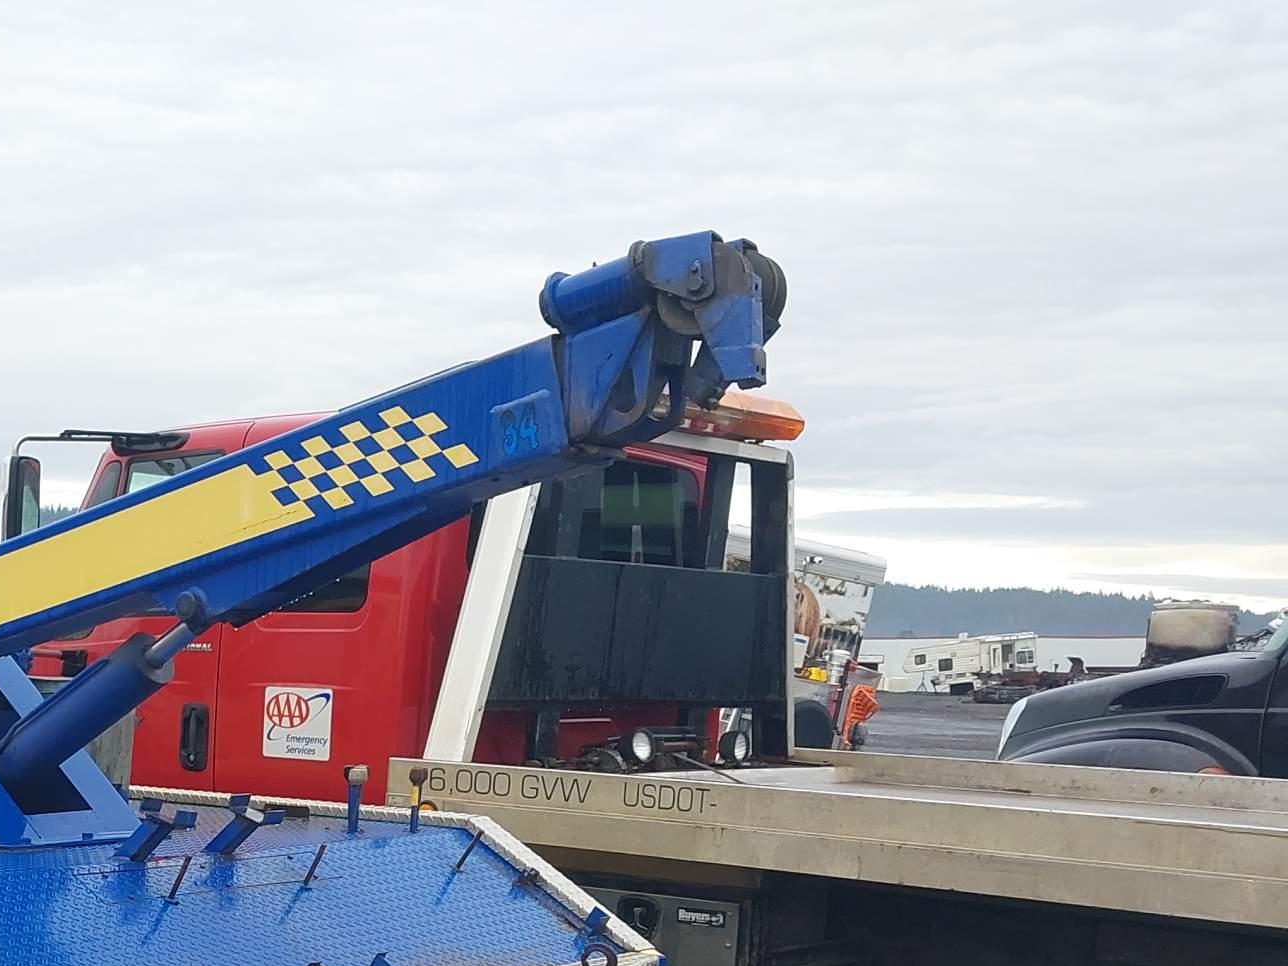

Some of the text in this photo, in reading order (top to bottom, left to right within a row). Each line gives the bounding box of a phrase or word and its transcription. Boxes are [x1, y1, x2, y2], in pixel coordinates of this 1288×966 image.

[500, 401, 539, 456] 34
[271, 692, 305, 727] AAA
[286, 734, 328, 747] Emergency
[286, 745, 316, 756] Services
[521, 775, 592, 804] GVW
[678, 908, 711, 922] Buyers
